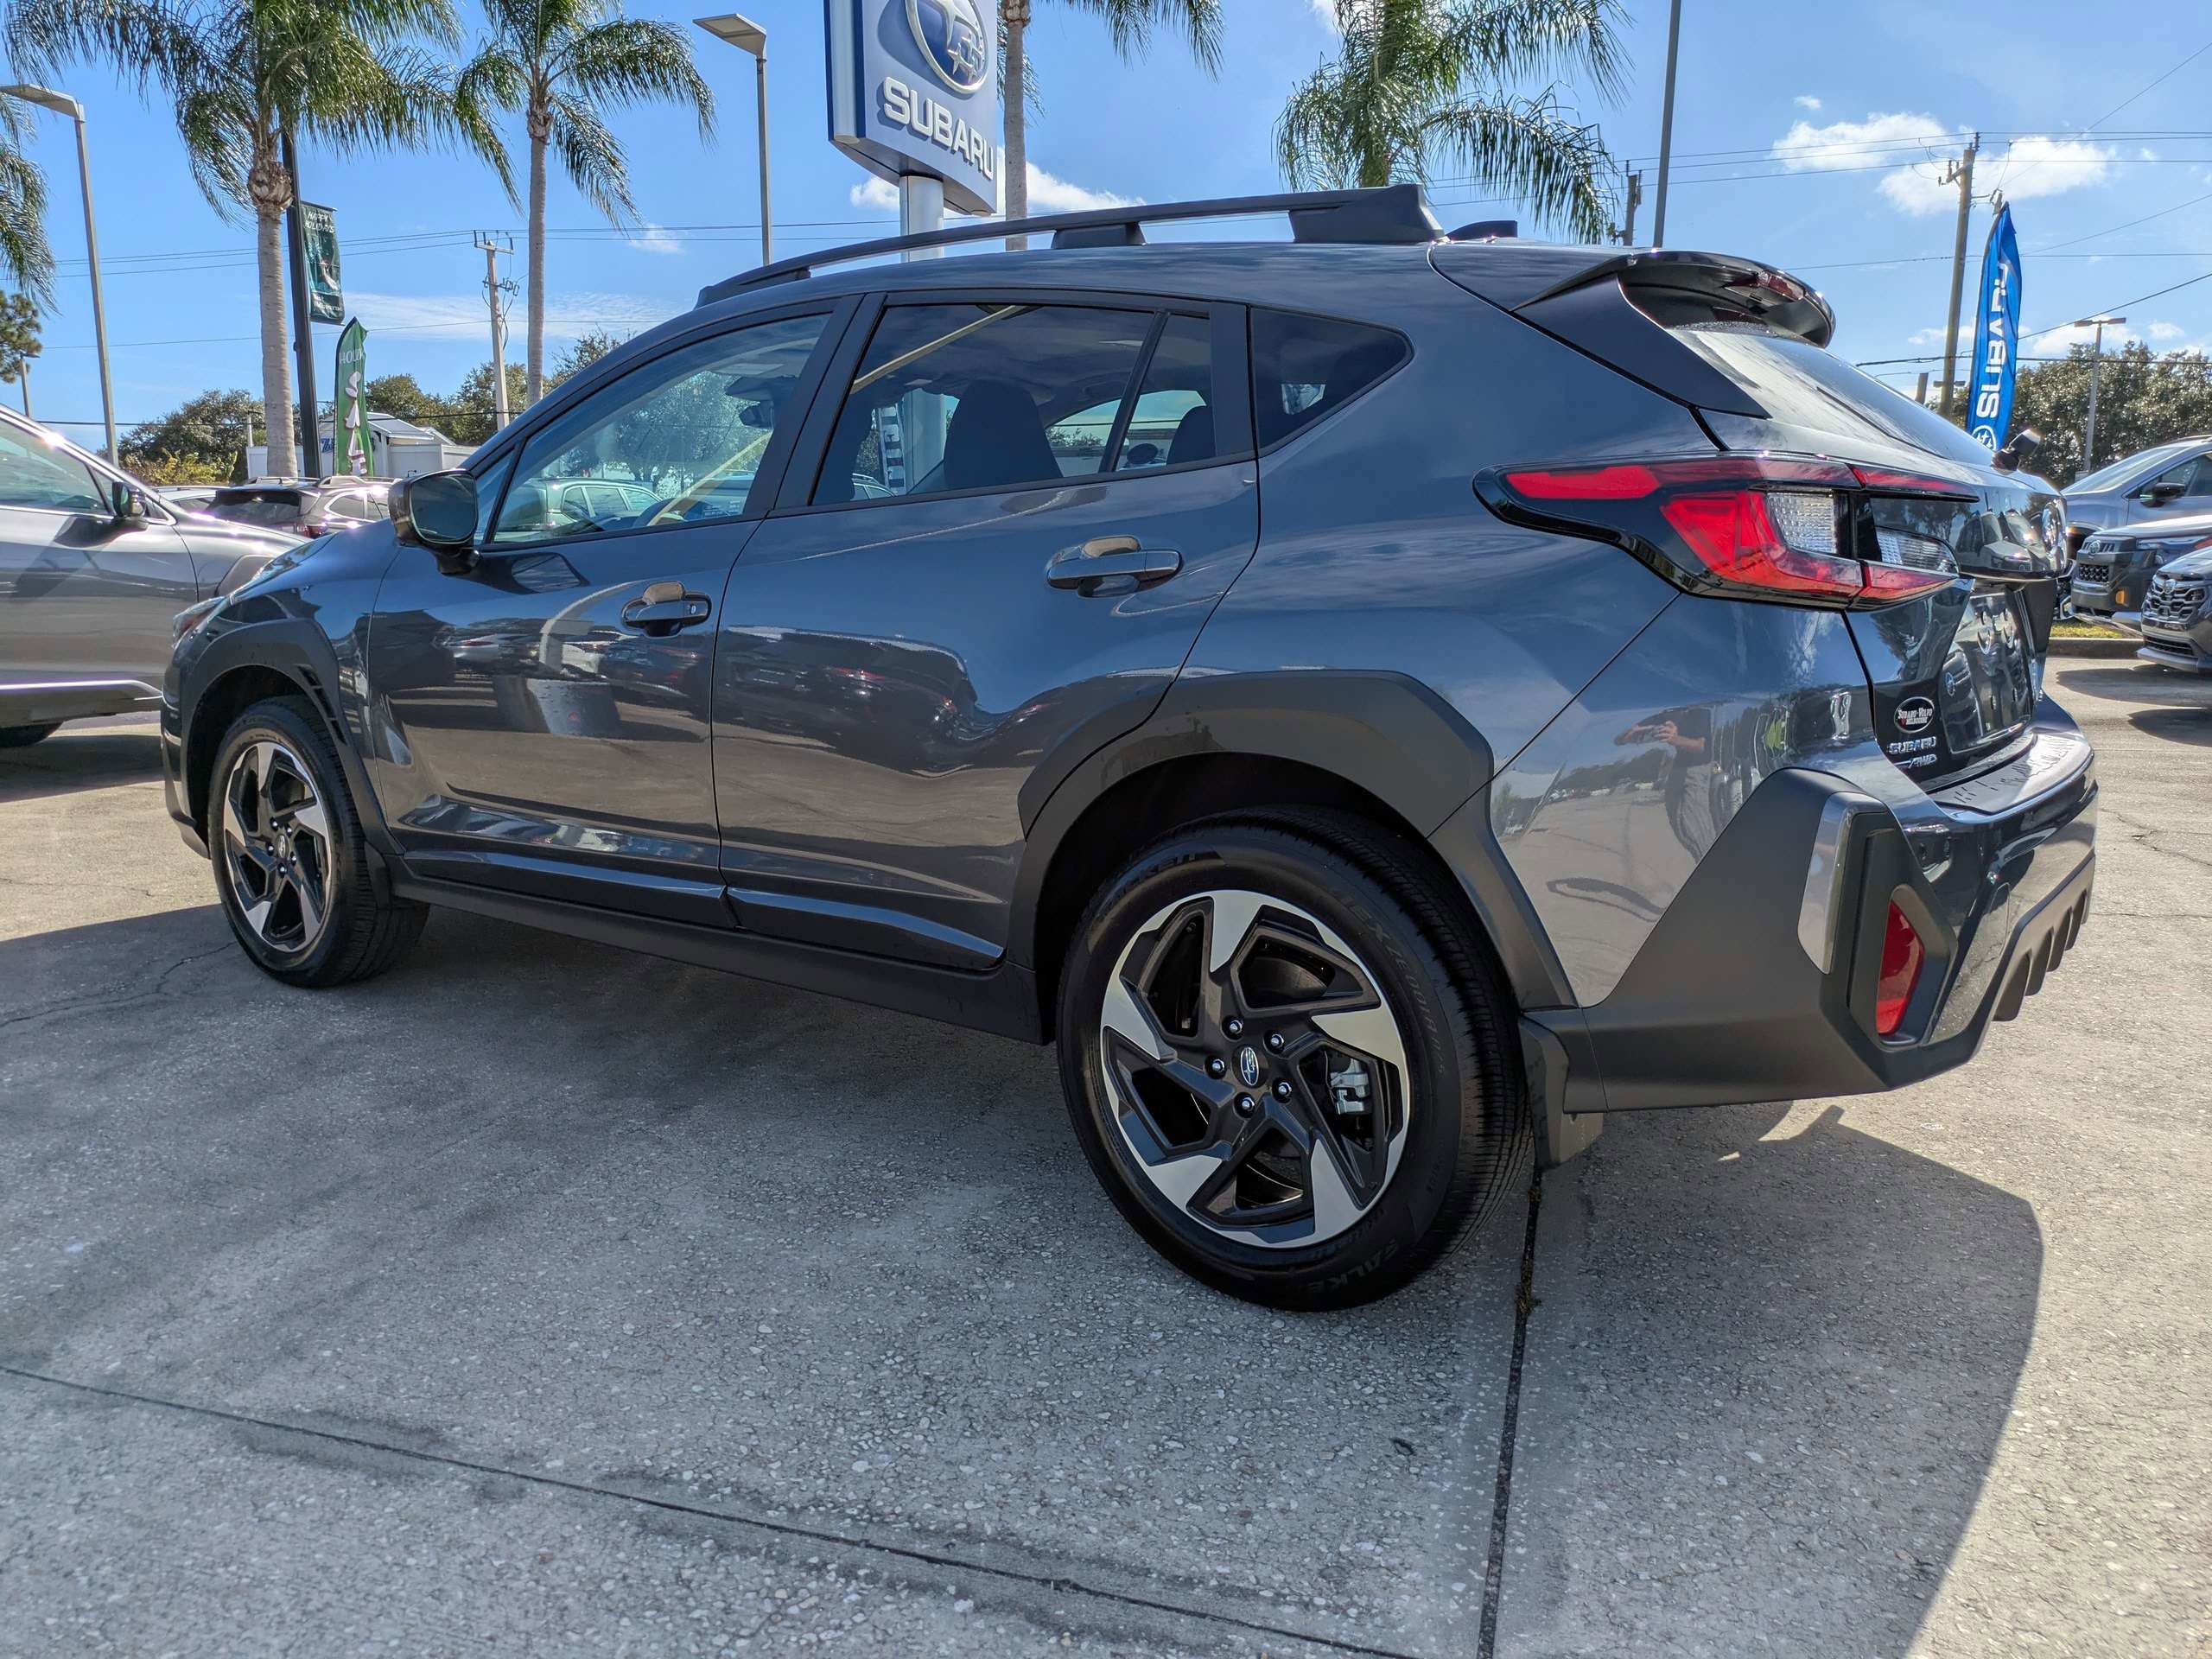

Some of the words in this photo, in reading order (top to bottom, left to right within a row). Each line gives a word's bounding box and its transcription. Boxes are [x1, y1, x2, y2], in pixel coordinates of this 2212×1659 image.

[884, 76, 994, 181] SUBARU
[1888, 736, 1936, 754] SUBARU
[1908, 753, 1937, 768] AWD
